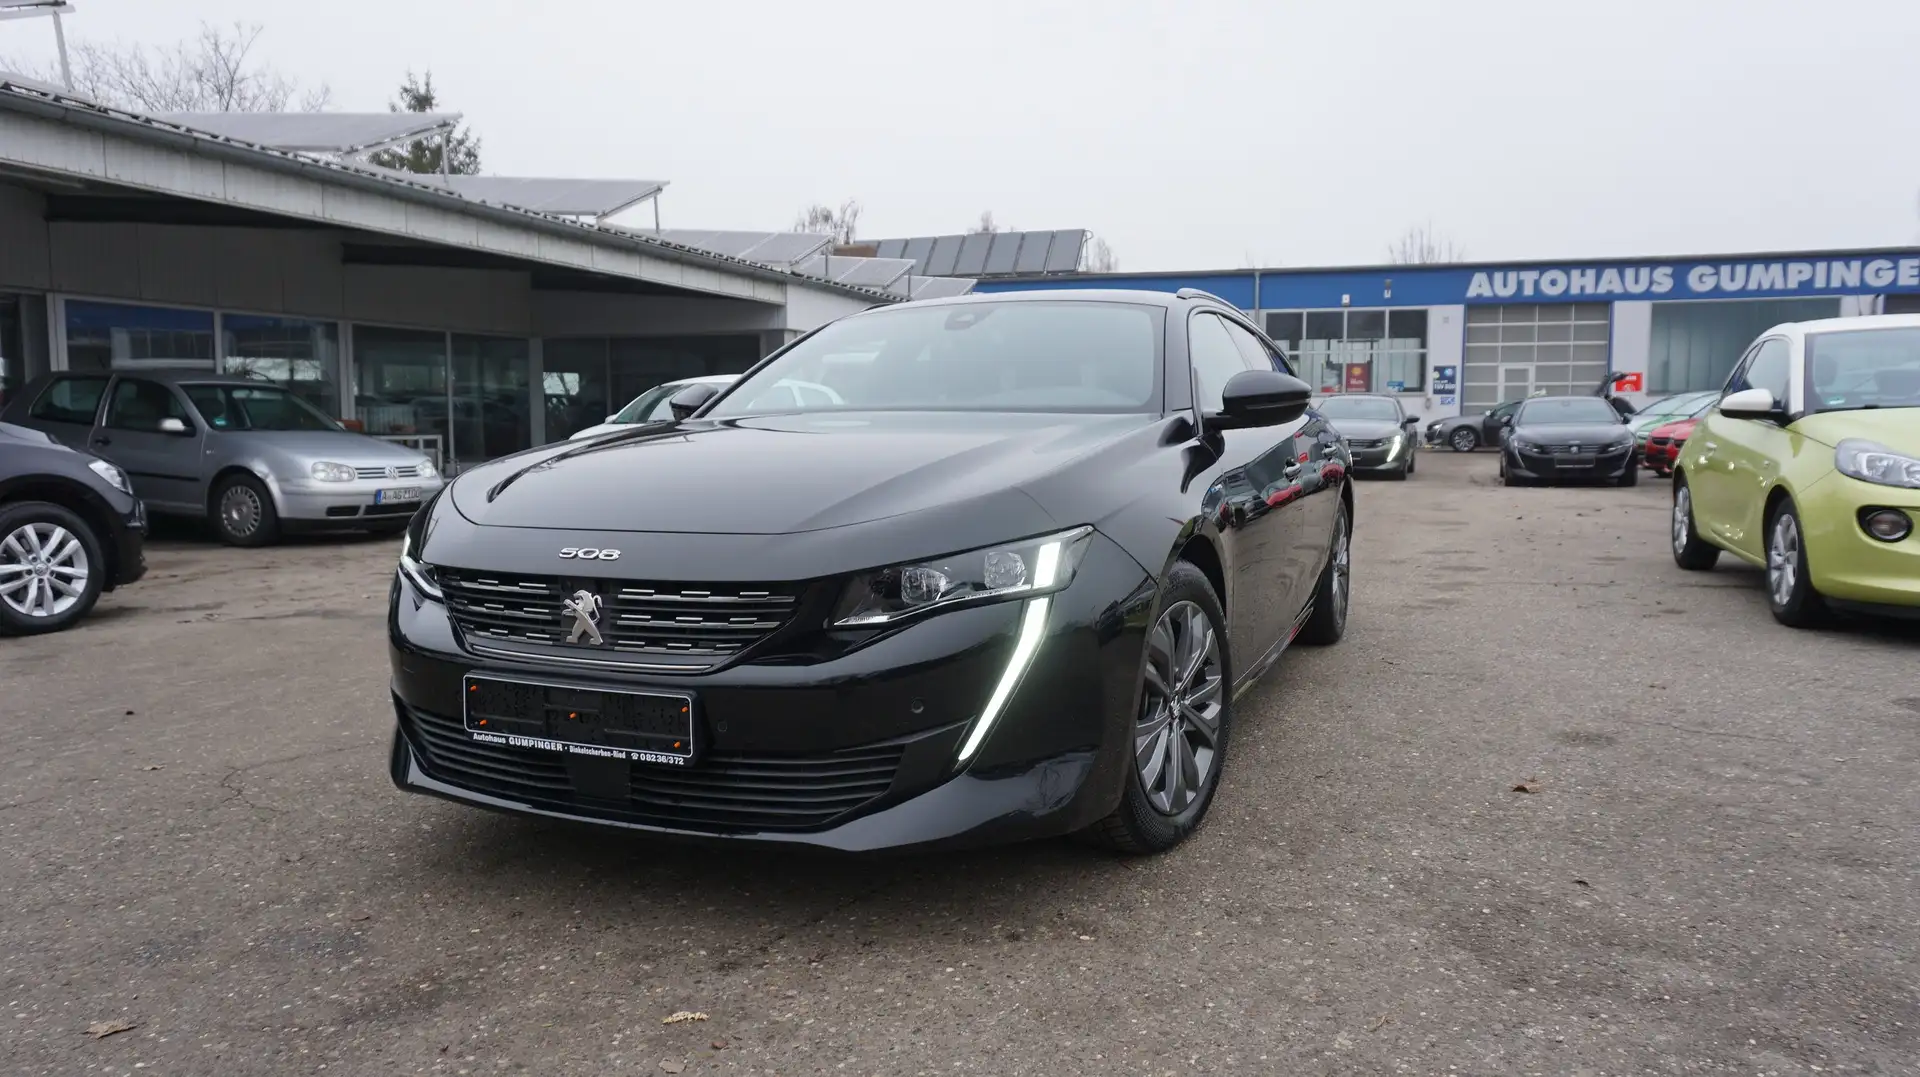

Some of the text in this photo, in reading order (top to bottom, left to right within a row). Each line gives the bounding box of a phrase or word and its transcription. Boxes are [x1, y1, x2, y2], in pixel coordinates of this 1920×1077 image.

[1466, 266, 1674, 298] AUTOHAUS
[559, 548, 621, 561] 508
[473, 733, 506, 743] Autohaus
[509, 737, 563, 751] GUMPINGER
[640, 753, 684, 765] 08236/372
